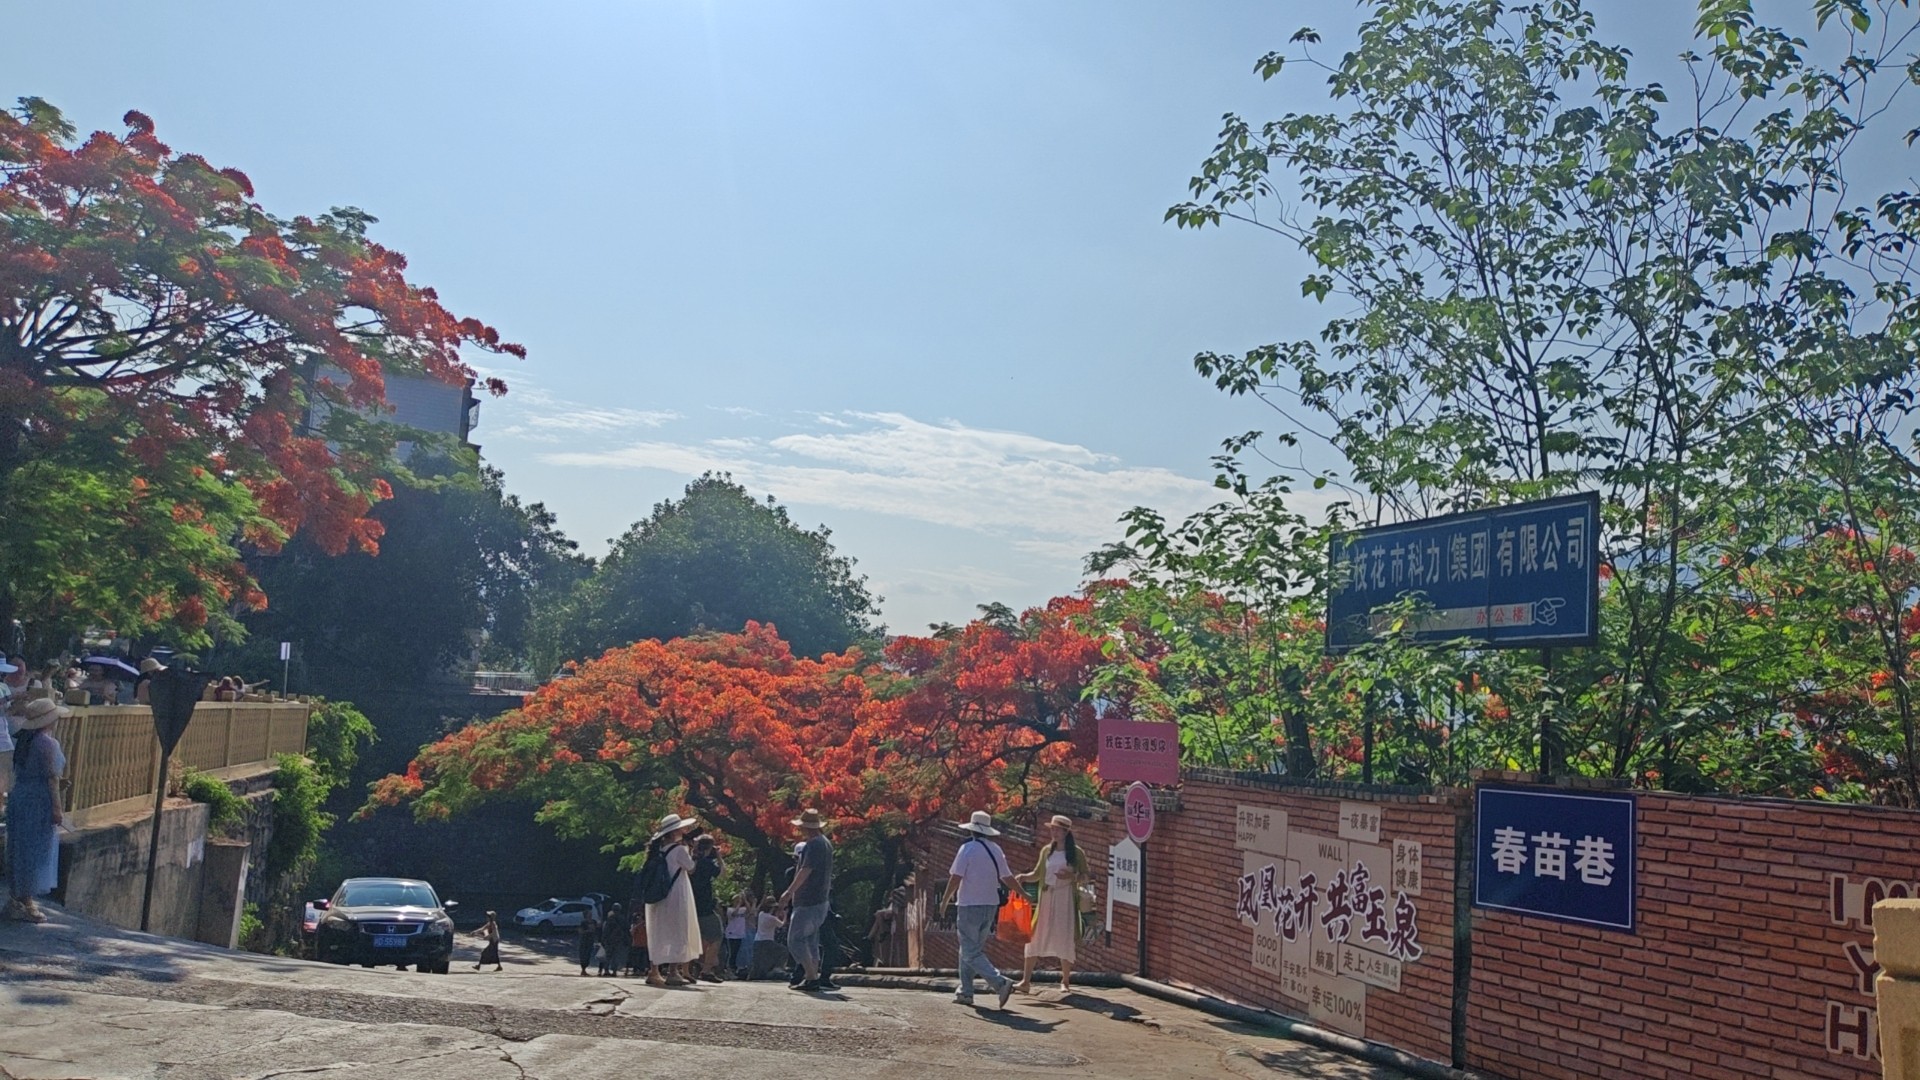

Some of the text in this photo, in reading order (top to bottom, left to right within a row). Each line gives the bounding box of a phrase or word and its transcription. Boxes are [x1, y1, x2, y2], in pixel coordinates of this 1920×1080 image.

[1238, 811, 1271, 832] 升职加薪
[1341, 812, 1378, 833] 一夜暴富
[1238, 831, 1256, 843] HAPPY
[1318, 843, 1343, 862] WALL
[1395, 843, 1419, 866] 身体
[1491, 825, 1615, 887] 春苗巷
[1395, 868, 1419, 891] 健康
[1833, 876, 1844, 922] I
[1256, 934, 1278, 952] GOOD
[1255, 951, 1277, 970] LUCK
[1311, 986, 1362, 1022] 幸运100%
